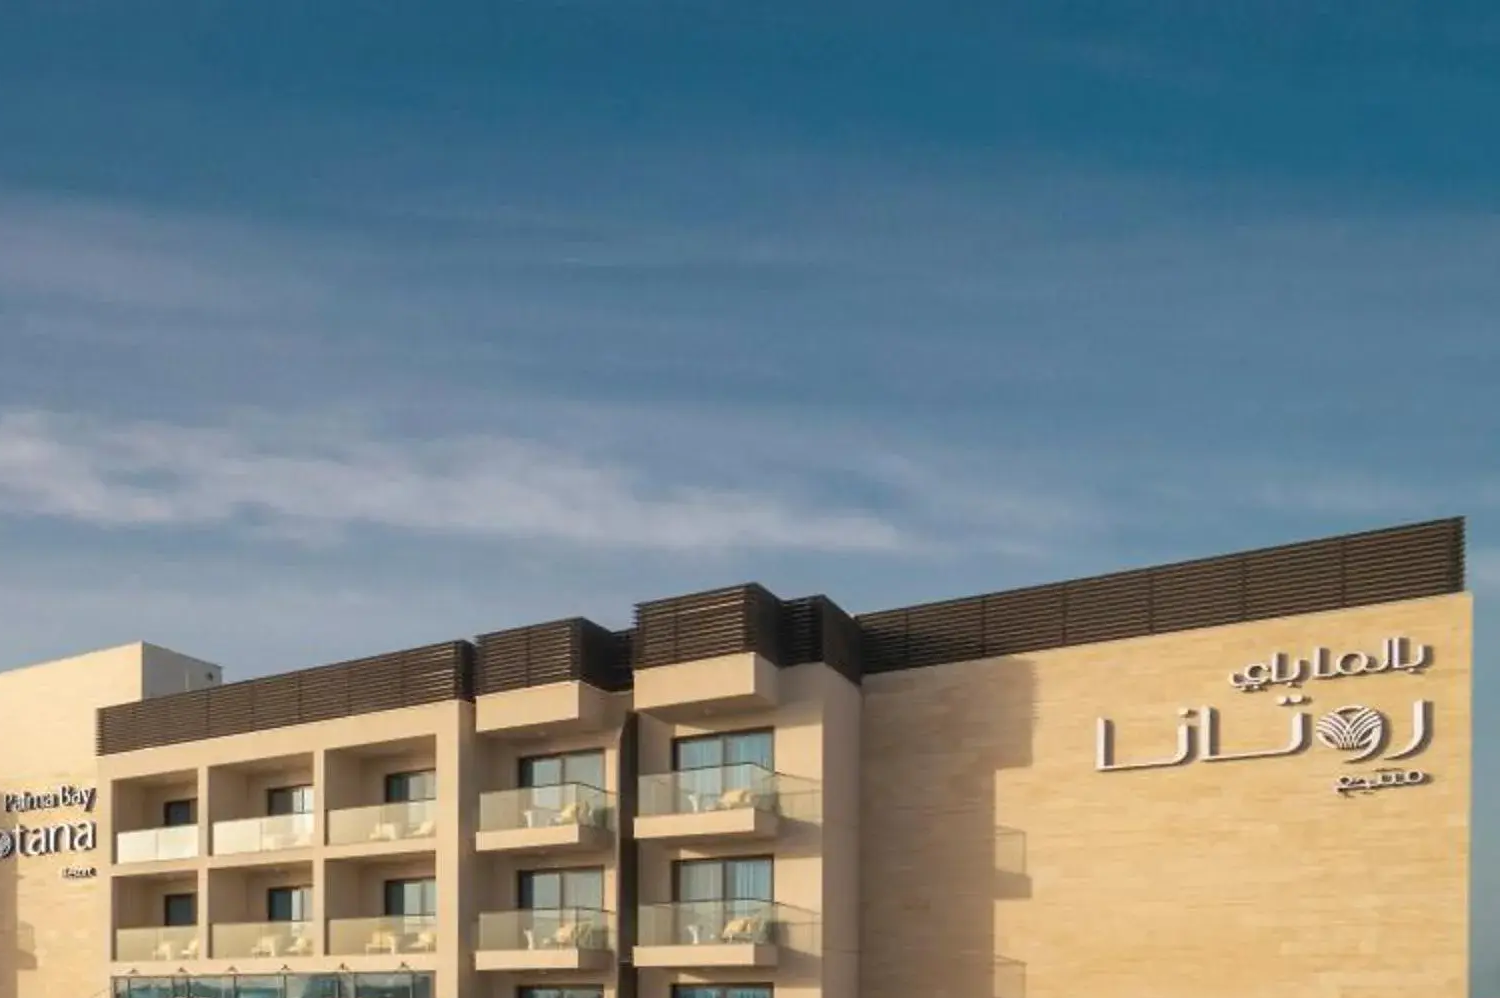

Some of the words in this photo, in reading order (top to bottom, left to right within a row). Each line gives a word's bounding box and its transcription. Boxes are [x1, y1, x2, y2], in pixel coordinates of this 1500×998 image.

[1312, 637, 1427, 680] بالما
[1095, 694, 1428, 772] روتانا
[60, 786, 97, 811] Bay
